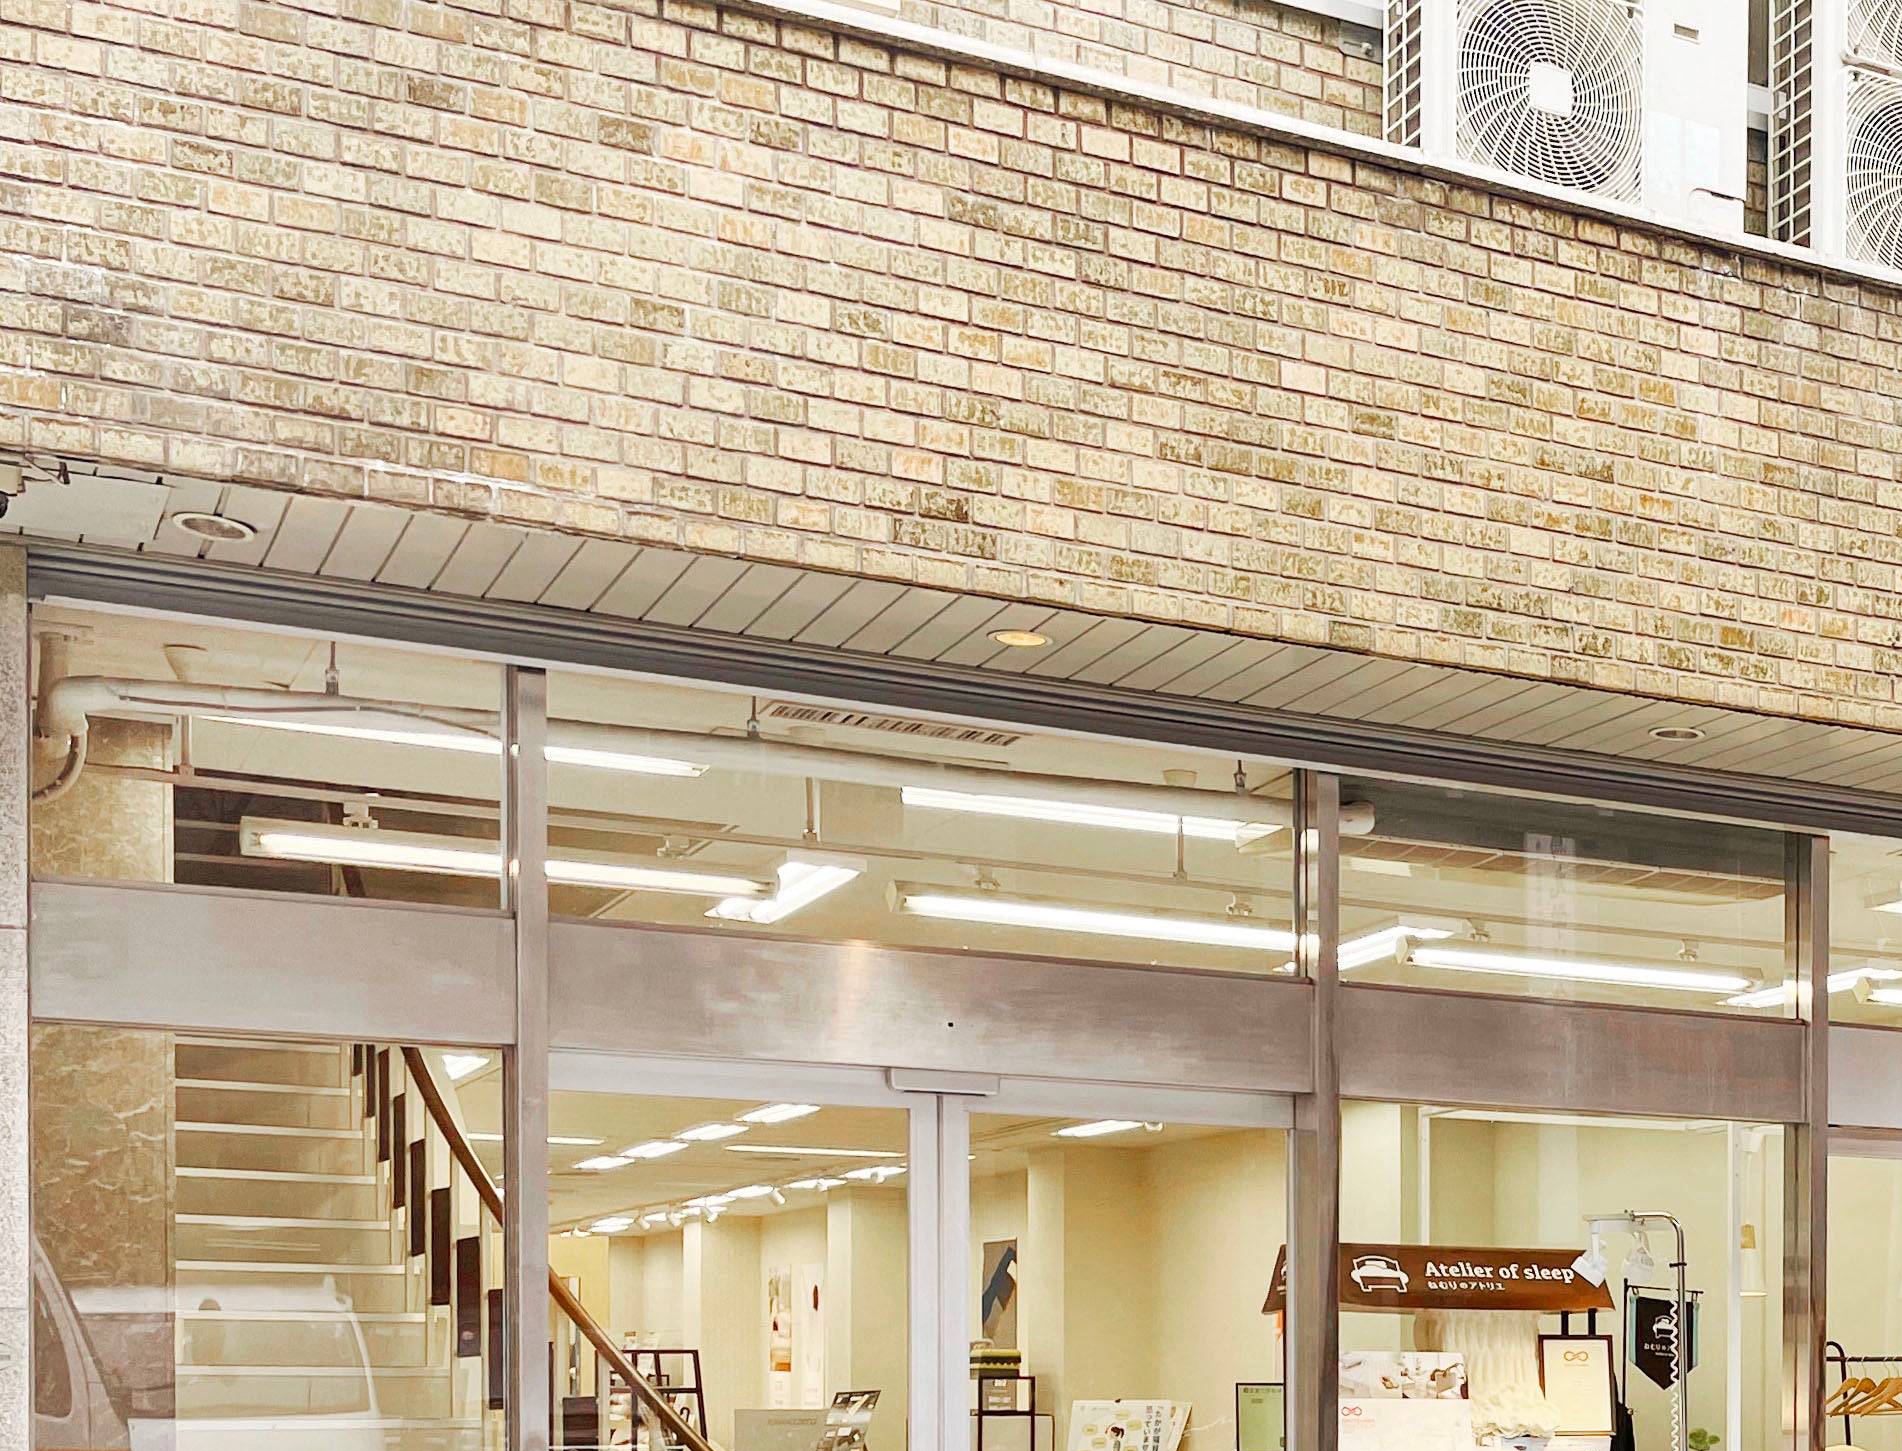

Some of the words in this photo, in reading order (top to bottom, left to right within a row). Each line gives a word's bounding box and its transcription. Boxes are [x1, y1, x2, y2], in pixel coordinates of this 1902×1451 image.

[1425, 1262, 1494, 1279] Atelier
[1499, 1264, 1519, 1280] of
[1524, 1264, 1575, 1284] sleep
